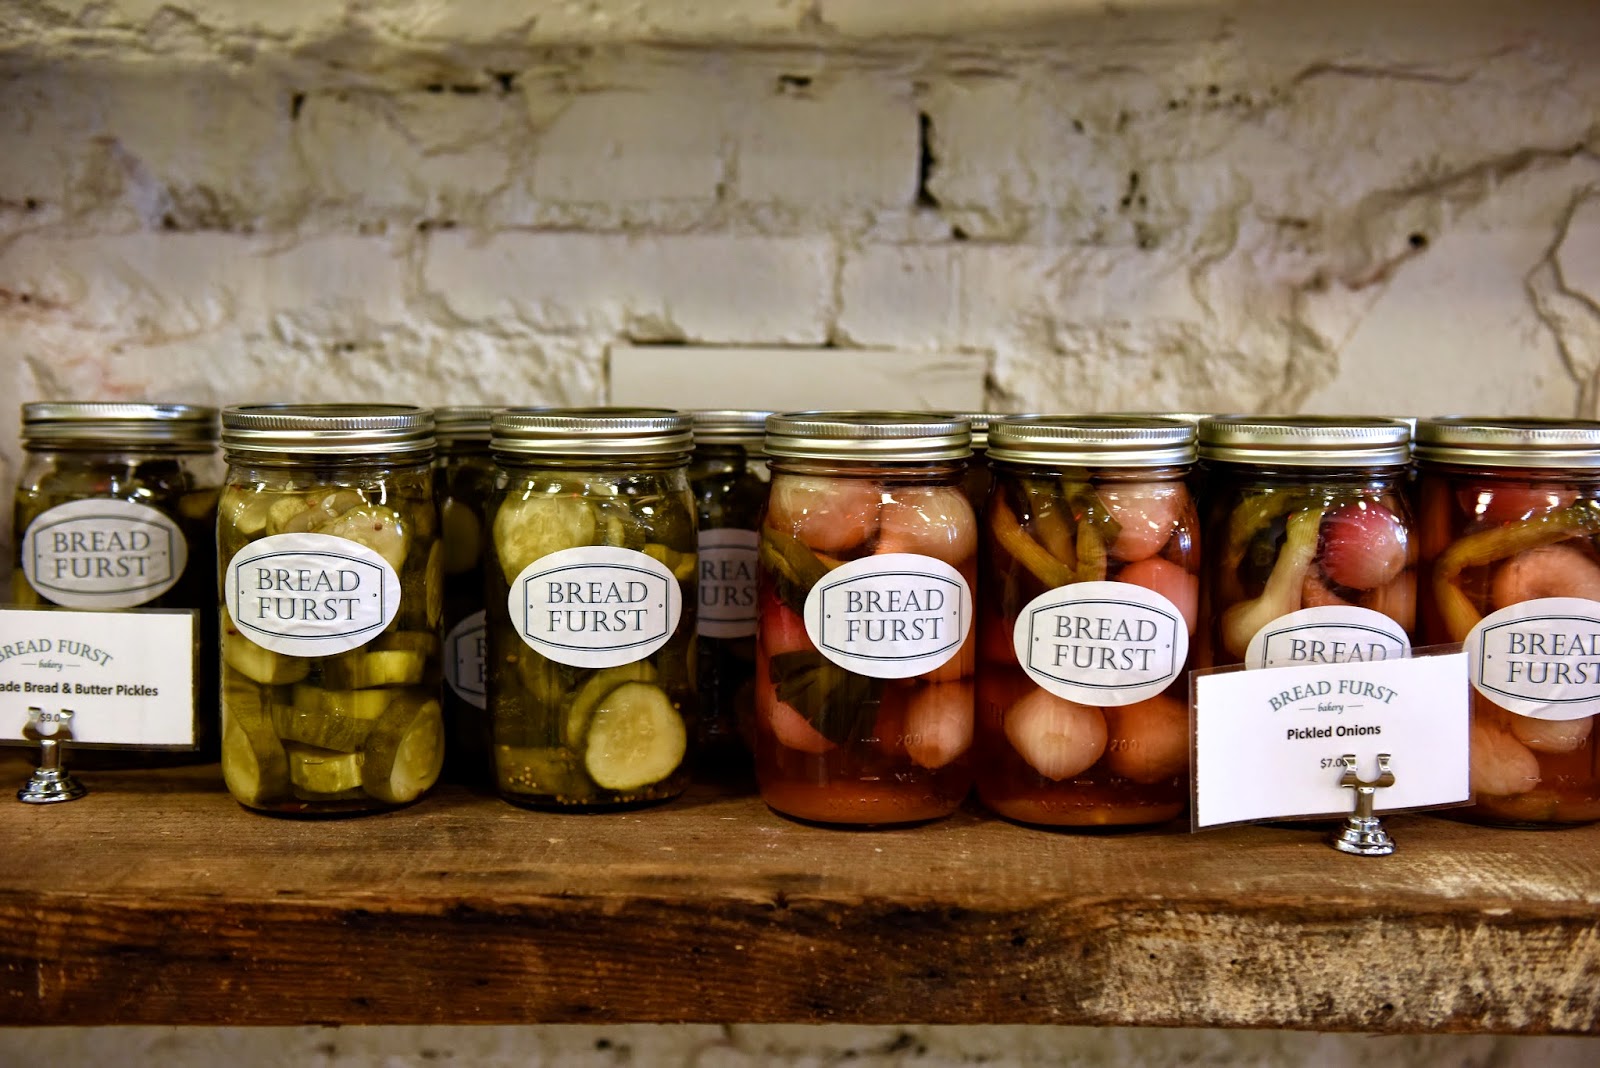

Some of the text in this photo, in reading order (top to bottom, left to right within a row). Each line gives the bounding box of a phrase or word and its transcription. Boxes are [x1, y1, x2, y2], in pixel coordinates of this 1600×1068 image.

[53, 530, 151, 553] BREAD
[53, 555, 151, 579] FURST
[701, 560, 752, 580] REA
[256, 567, 360, 592] BREAD
[546, 581, 648, 604] BREAD
[701, 585, 754, 606] URS
[844, 589, 945, 614] BREAD
[256, 597, 360, 621] FURST
[547, 609, 648, 632] FURST
[844, 617, 944, 642] FURST
[1053, 615, 1158, 643] BREAD
[57, 639, 114, 667] FURST
[1051, 644, 1156, 671] FURST
[1288, 638, 1387, 663] BREAD
[38, 659, 63, 672] bakery
[24, 682, 59, 693] Bread
[62, 683, 72, 694] &
[75, 683, 113, 695] Butter
[116, 685, 159, 697] Pickles
[1268, 679, 1398, 712] BREAD FURST
[41, 712, 60, 722] $9.0
[1317, 702, 1344, 714] bakery
[1287, 724, 1381, 740] Pickled Onions
